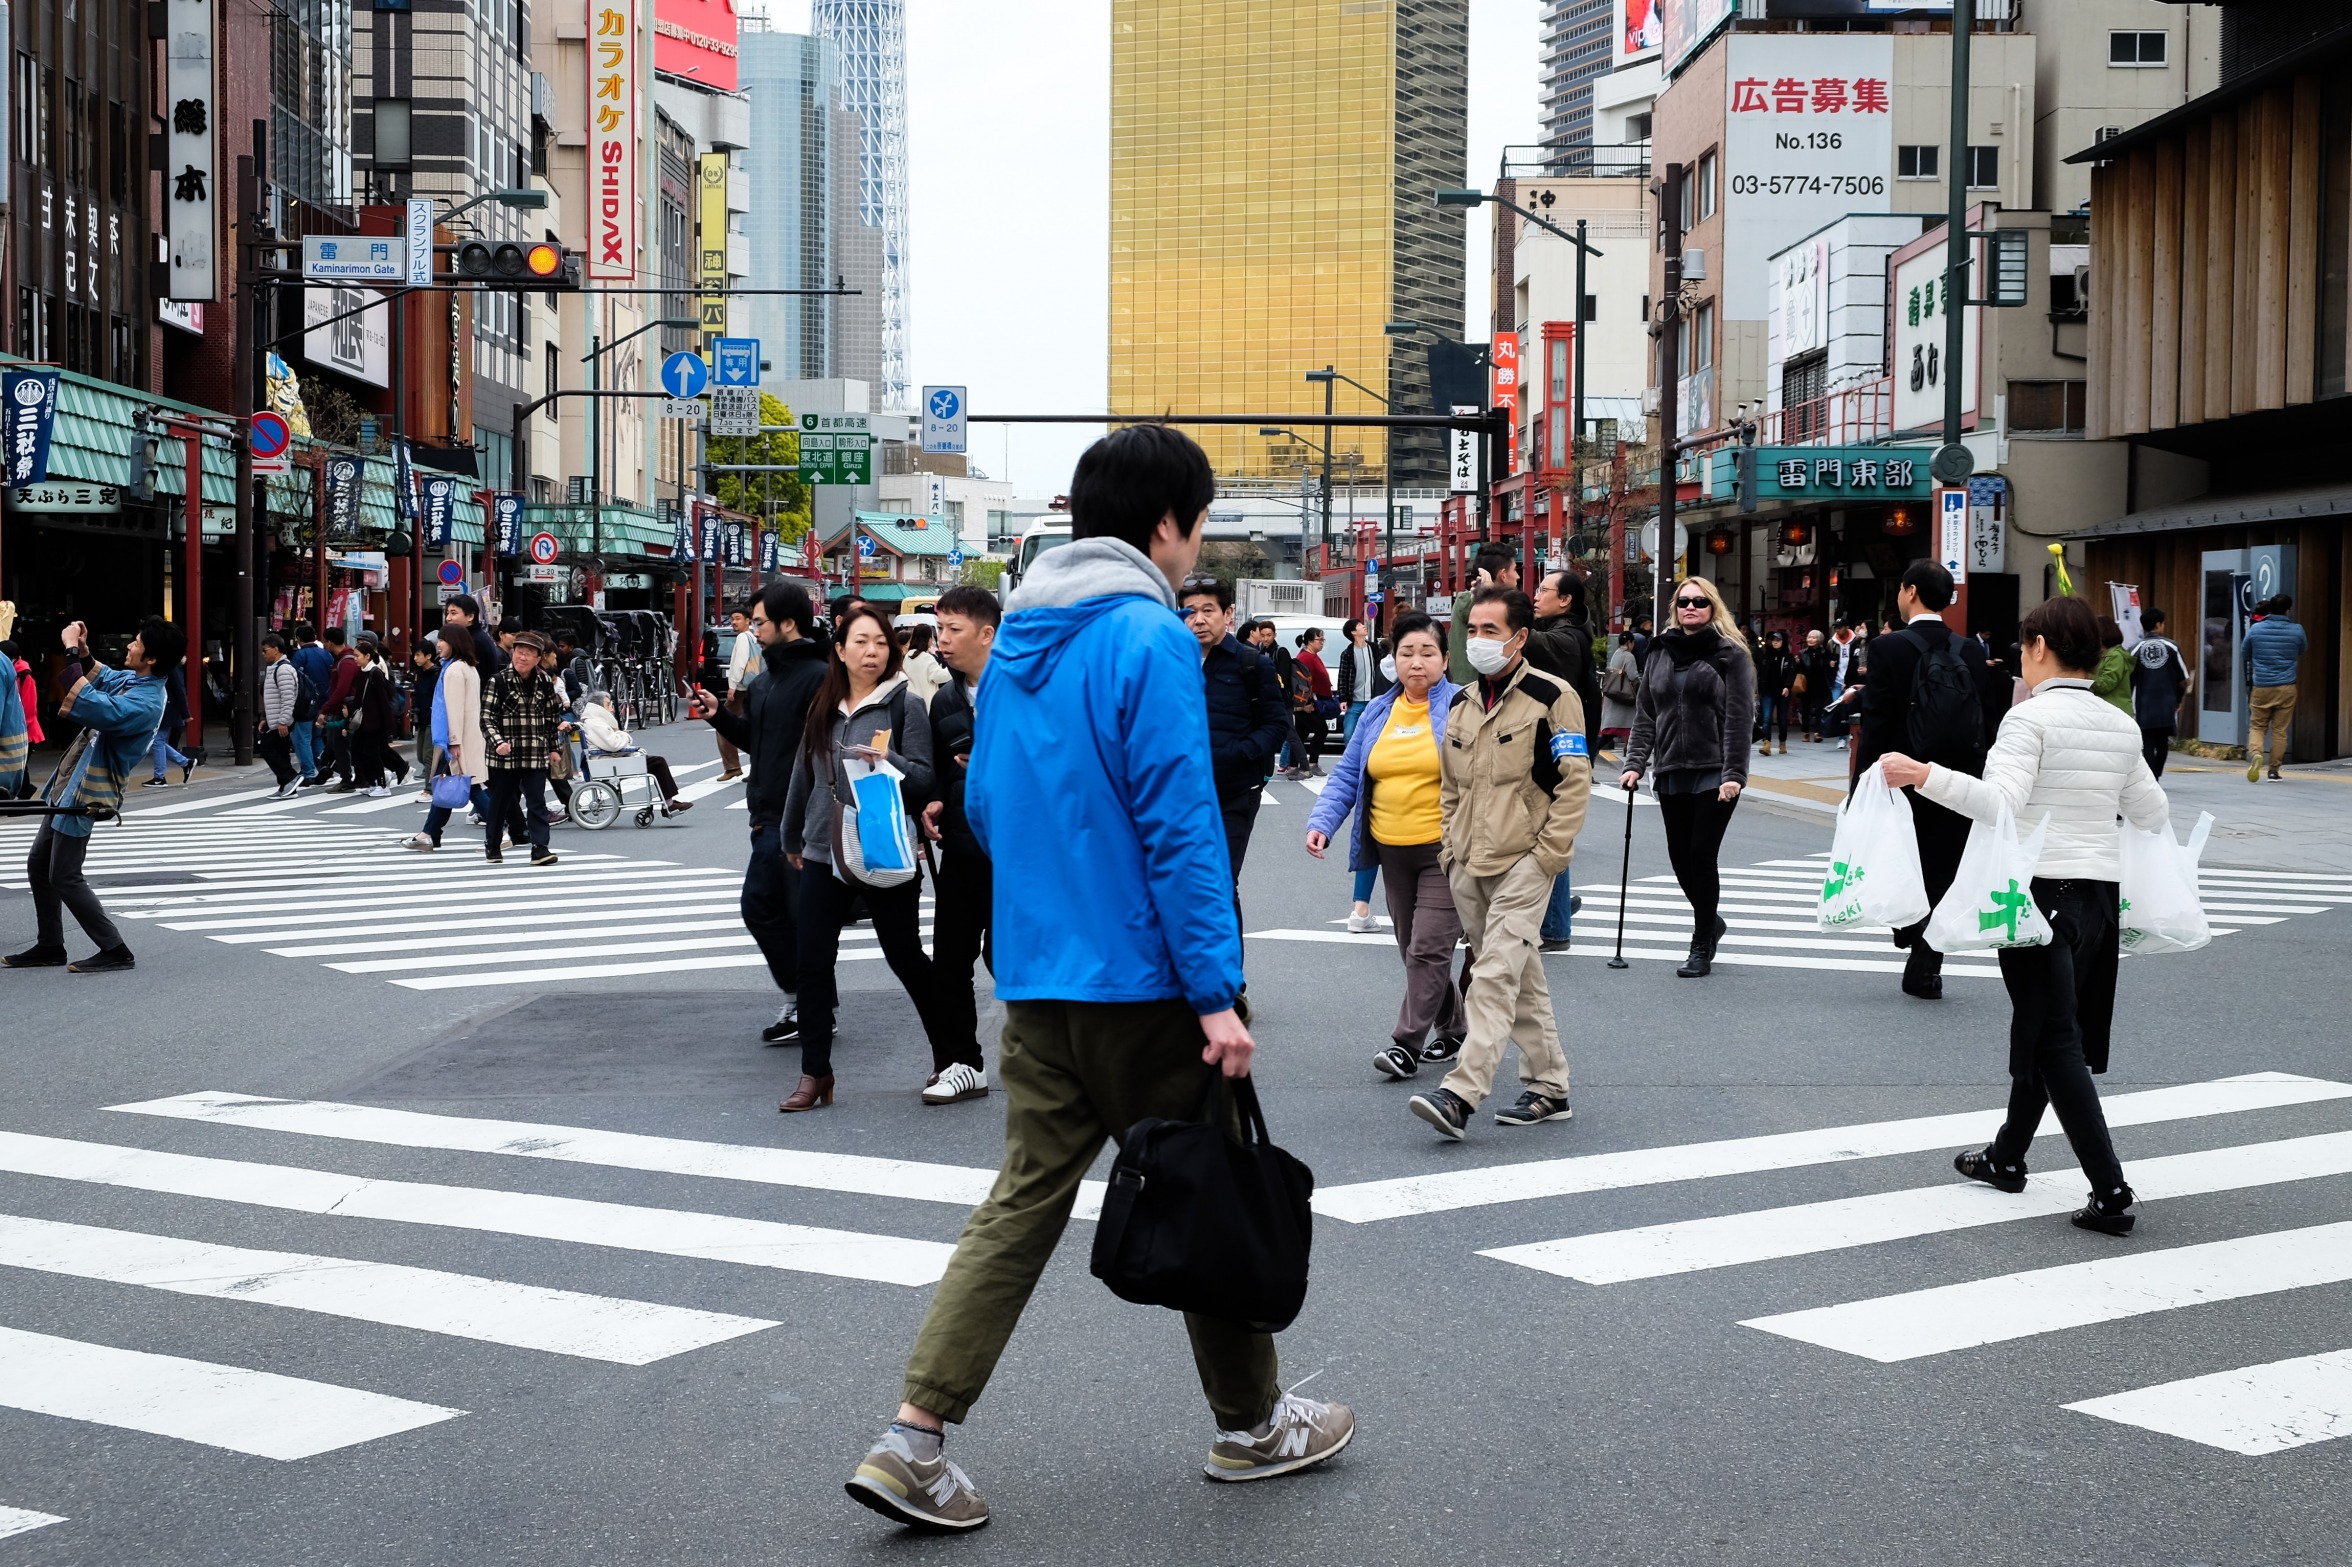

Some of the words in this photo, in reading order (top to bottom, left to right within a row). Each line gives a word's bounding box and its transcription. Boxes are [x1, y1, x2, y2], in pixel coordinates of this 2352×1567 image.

[597, 8, 625, 132] カラオケ
[1731, 77, 1889, 114] 広告募集
[1776, 132, 1842, 149] No.136
[1732, 175, 1884, 195] 03-5774-7506
[602, 141, 623, 264] SHIDAX
[320, 242, 388, 260] 雷門
[412, 203, 427, 282] スクランブル式
[312, 263, 371, 274] Kaminarimon
[374, 264, 395, 274] Gate
[806, 416, 814, 426] 6
[821, 417, 867, 428] 首都高速
[16, 407, 39, 480] 三社祭
[800, 451, 833, 462] 東北道
[841, 452, 864, 462] 銀座
[1778, 458, 1913, 488] 雷門東部
[931, 483, 940, 514] 水上バ
[431, 497, 446, 542] 三社祭
[500, 514, 513, 552] 三社祭
[703, 531, 714, 559] 三社祭
[730, 536, 739, 564] 三社祭
[763, 543, 773, 569] 三社祭
[1279, 1428, 1309, 1456] N
[926, 1472, 957, 1507] N
